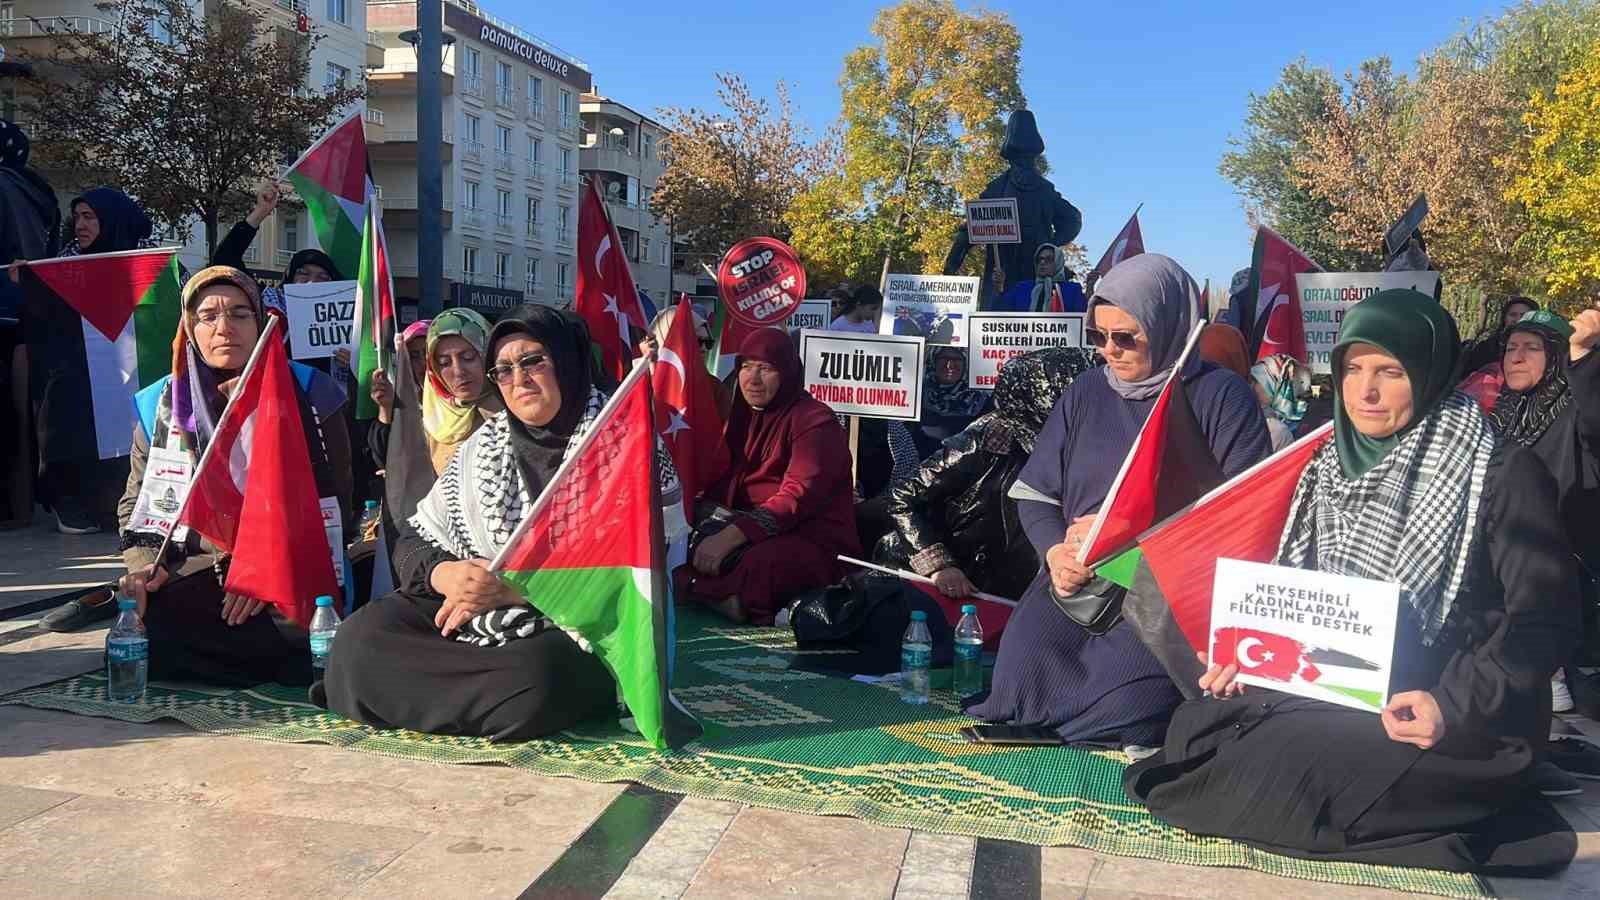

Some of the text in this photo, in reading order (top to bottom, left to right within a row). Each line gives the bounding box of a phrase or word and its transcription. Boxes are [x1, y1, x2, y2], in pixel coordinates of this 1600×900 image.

[481, 25, 568, 77] pamukcu deluxe
[731, 249, 774, 279] STOP
[737, 275, 796, 311] KILLING OF
[1303, 288, 1332, 301] ORTA
[314, 301, 356, 322] GAZZ
[753, 292, 794, 320] GAZA
[308, 322, 352, 346] ÖLÜY
[981, 321, 1068, 333] SUSKUN İSLAM
[1306, 331, 1337, 344] EVLET
[982, 335, 1068, 347] ÜLKELERİ DAHA
[818, 349, 903, 383] ZULÜMLE
[982, 349, 1006, 360] KAÇ
[975, 375, 998, 385] BEK
[809, 382, 910, 407] PAYİDAR OLUNMAZ.
[1244, 592, 1359, 621] KADINLARDAN
[1256, 583, 1351, 607] NEVŞEHİRLİ
[1229, 600, 1374, 636] FİLİSTİNE DESTEK
